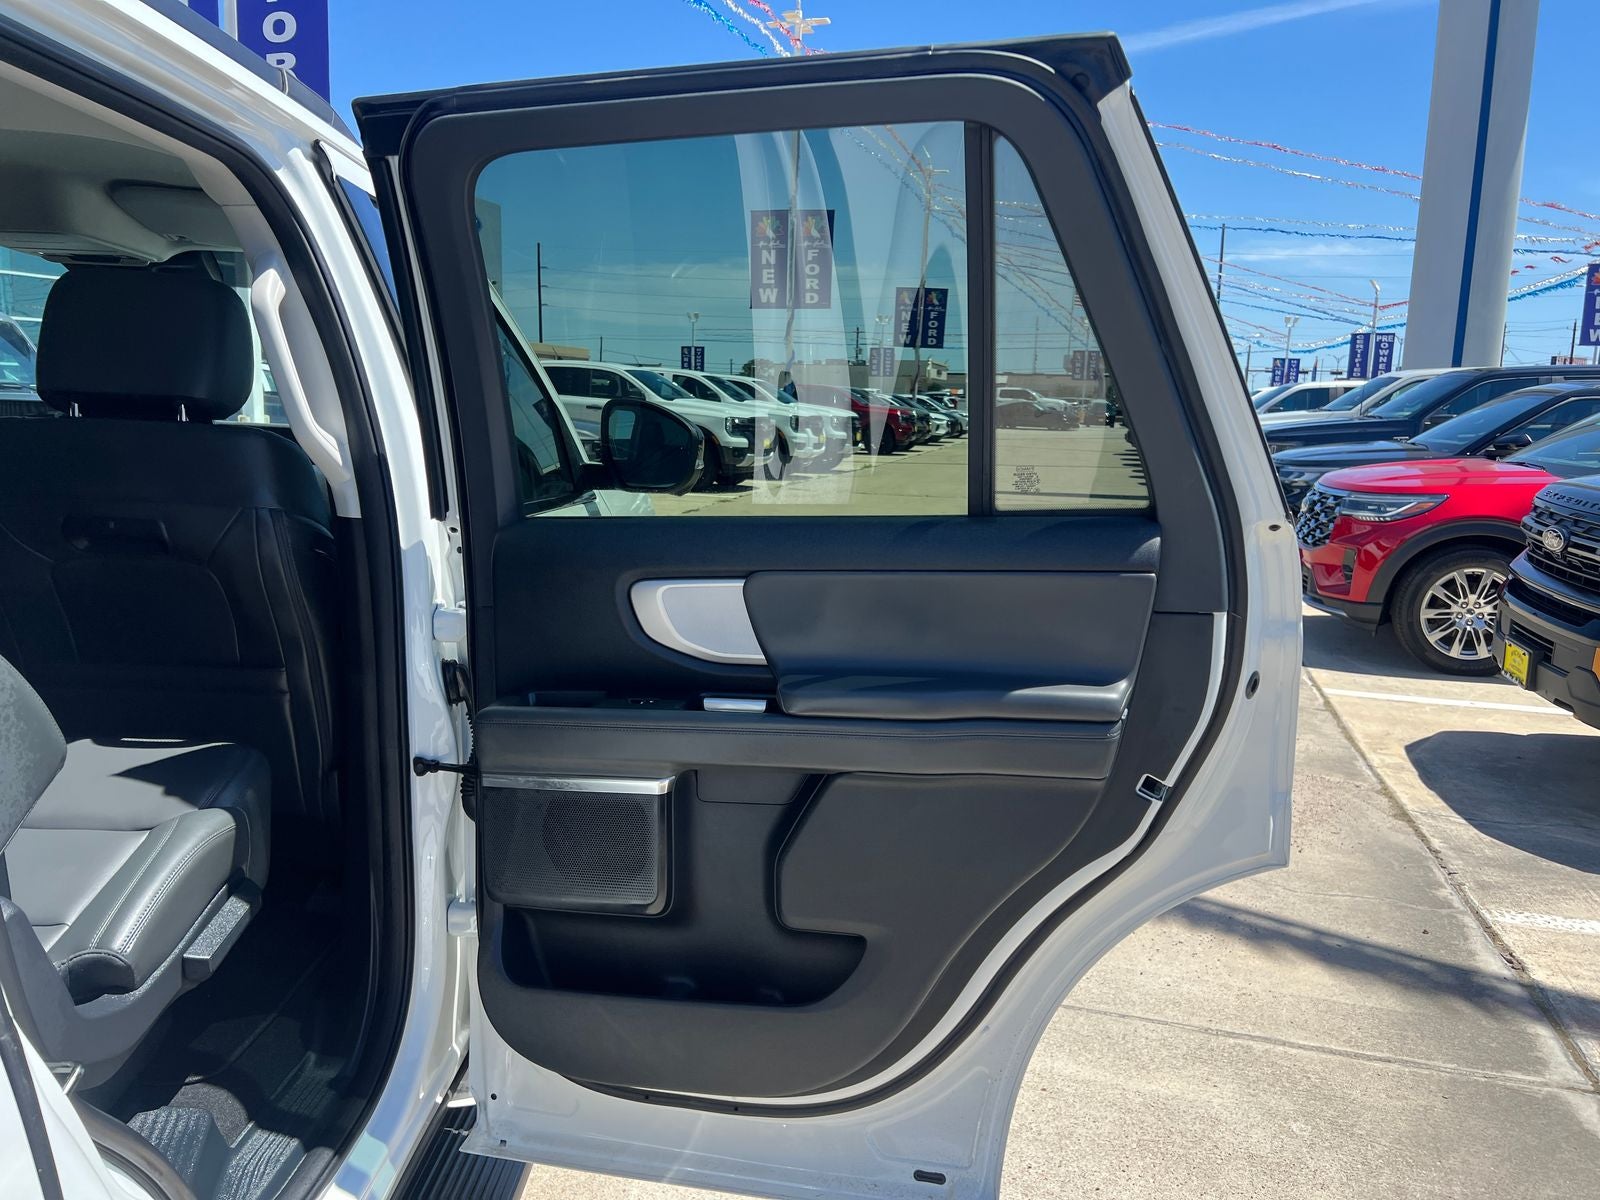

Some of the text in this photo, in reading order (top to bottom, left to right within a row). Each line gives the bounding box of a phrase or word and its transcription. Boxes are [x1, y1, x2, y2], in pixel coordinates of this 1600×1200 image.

[262, 0, 297, 80] OR
[759, 250, 778, 303] NEW
[805, 250, 820, 304] FORD
[899, 311, 912, 345] NEW
[927, 311, 939, 345] FORD
[1352, 335, 1364, 377] CERTIFIED
[1378, 342, 1389, 376] OWNED
